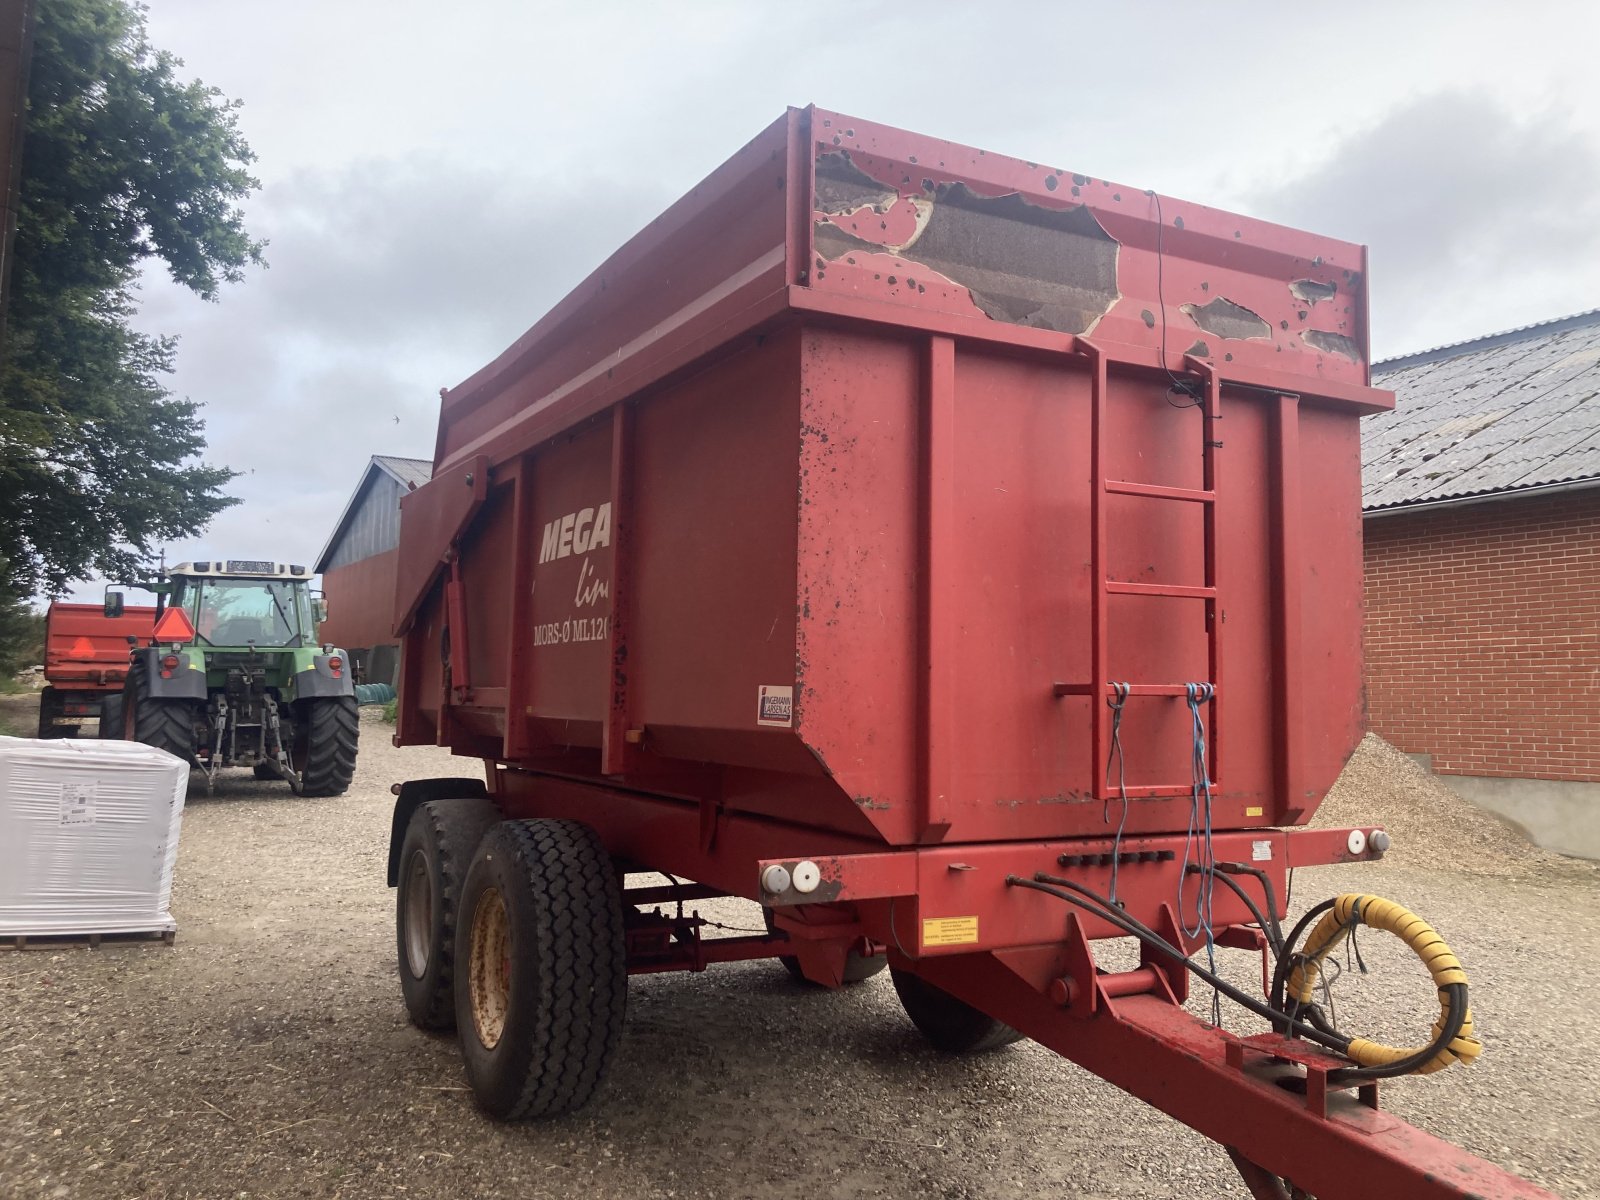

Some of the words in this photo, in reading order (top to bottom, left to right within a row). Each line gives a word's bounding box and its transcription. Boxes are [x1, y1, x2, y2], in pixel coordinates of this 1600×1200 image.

[539, 502, 612, 564] MEGA
[574, 556, 609, 608] lin
[533, 615, 571, 646] MORS-Ø
